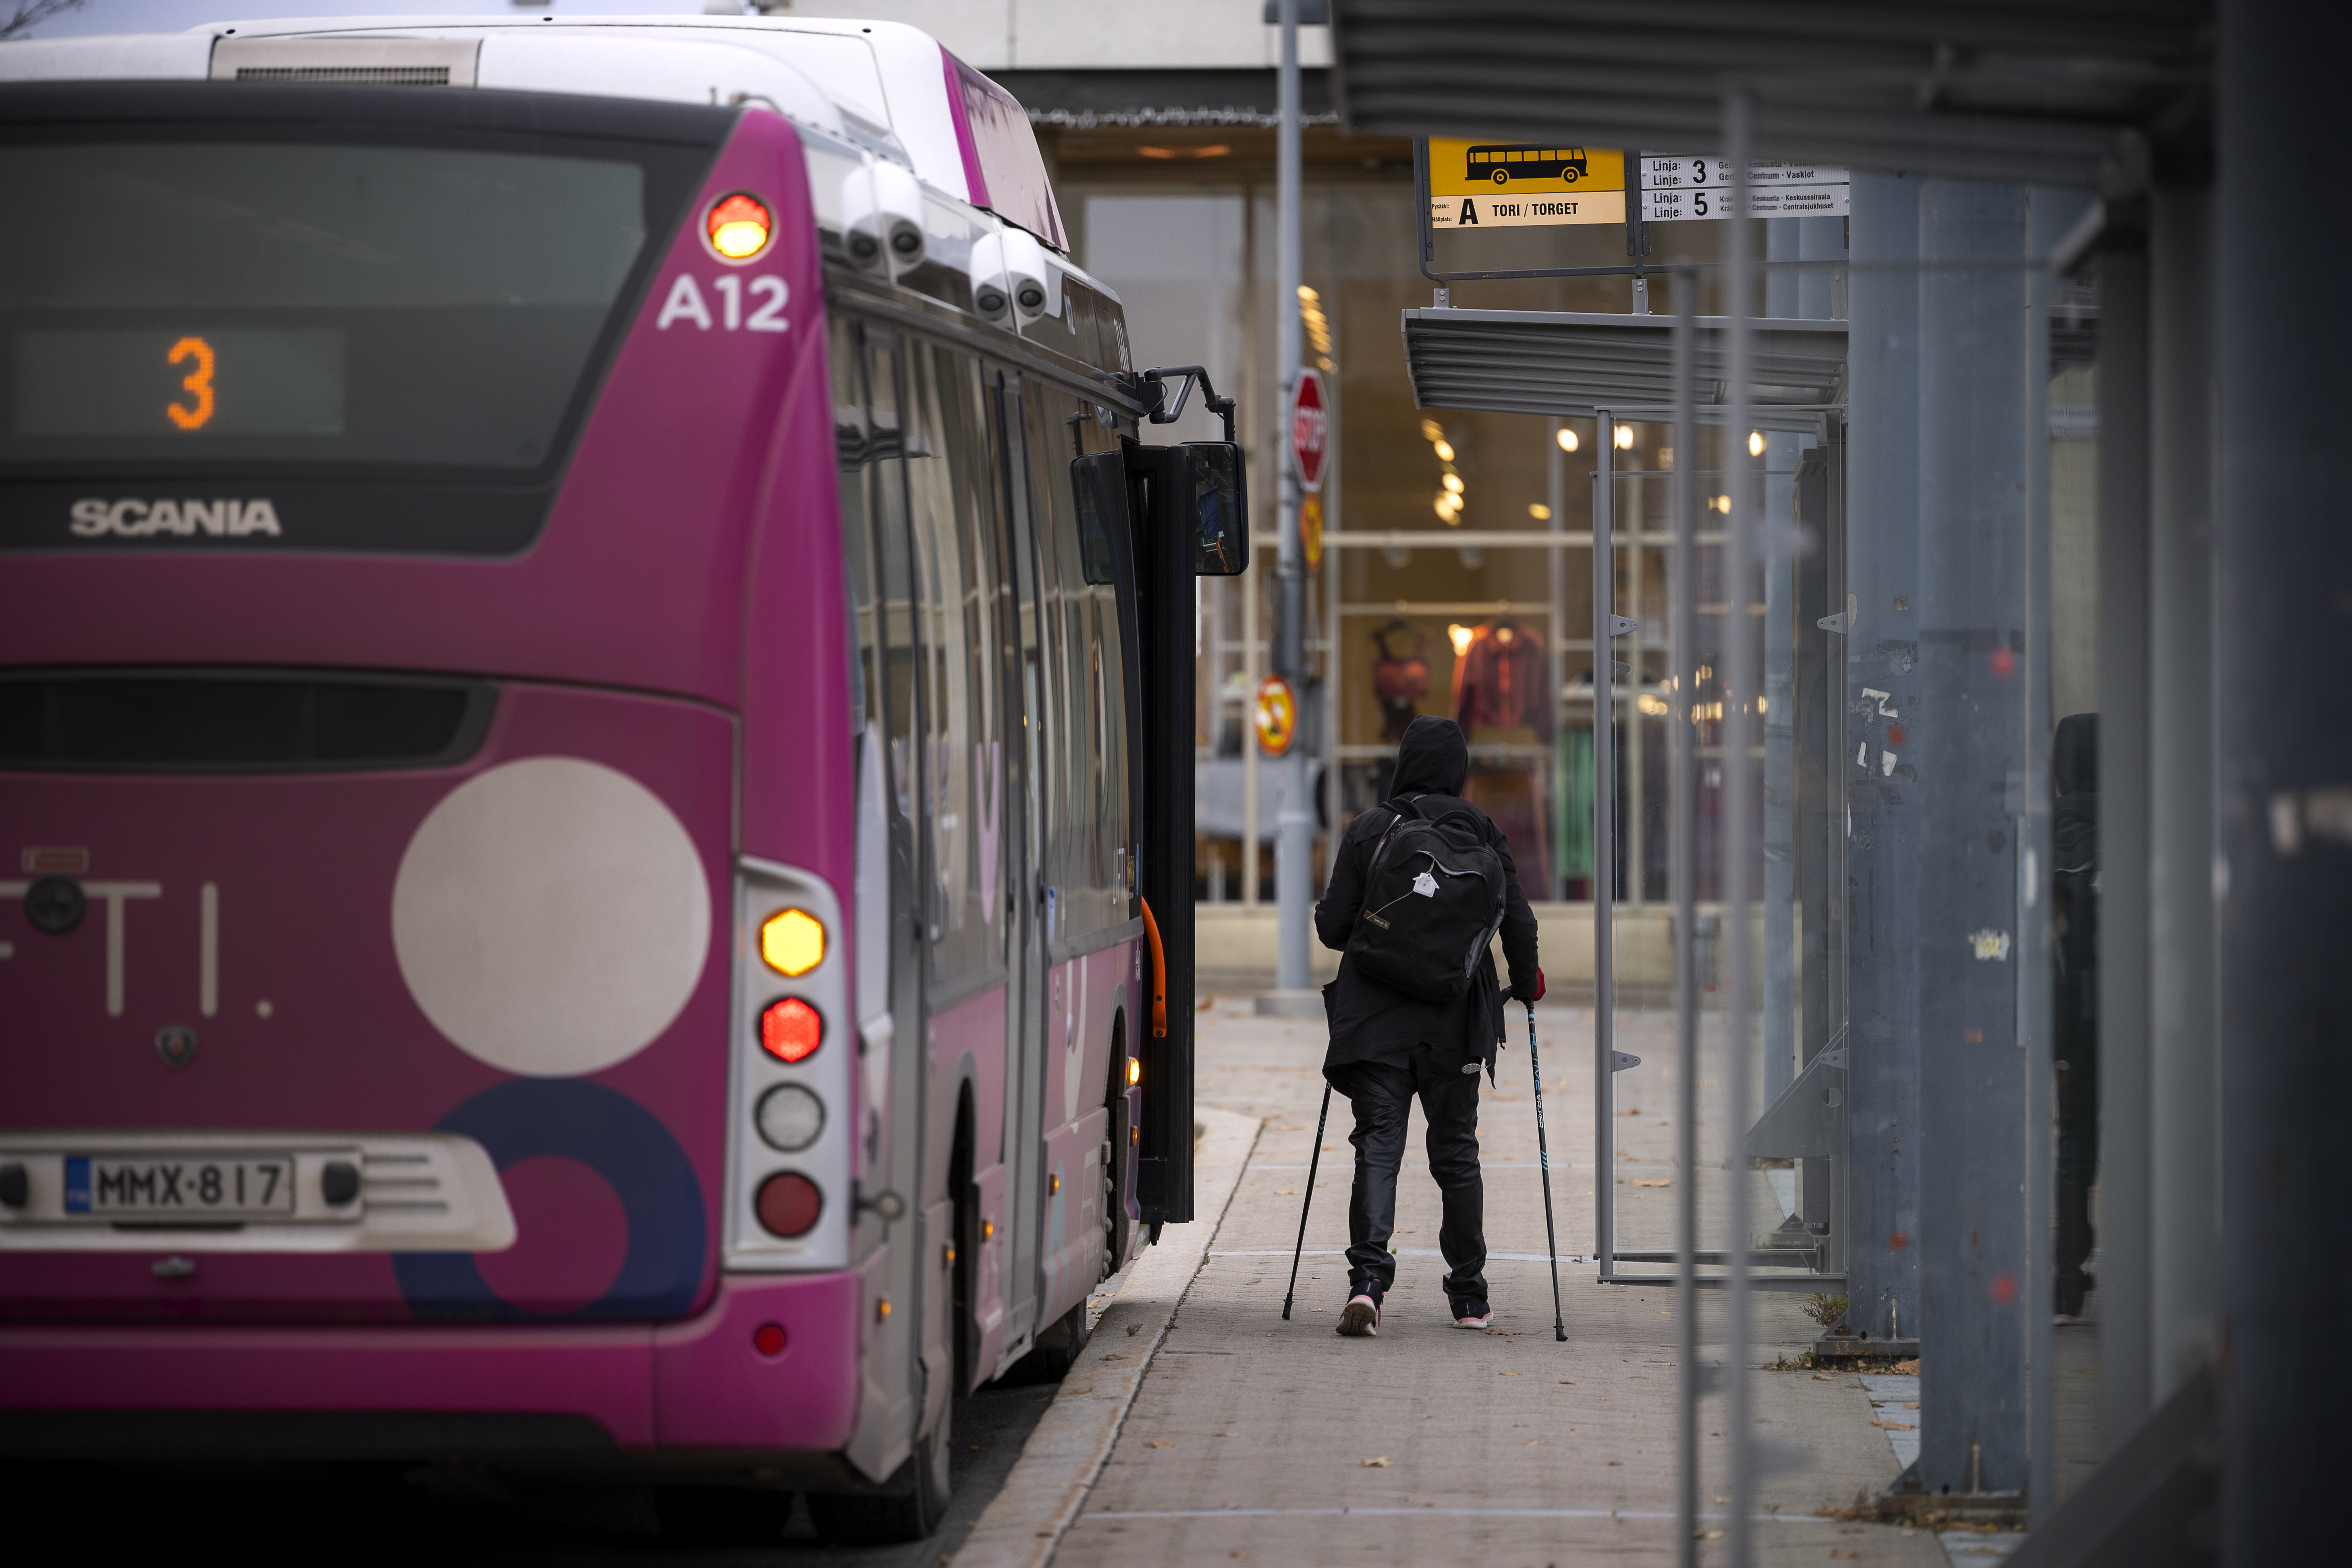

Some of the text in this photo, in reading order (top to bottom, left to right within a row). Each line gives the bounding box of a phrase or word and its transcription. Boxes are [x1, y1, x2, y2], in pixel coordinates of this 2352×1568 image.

[1653, 160, 1680, 172] Linja:
[1693, 160, 1706, 183] 3
[1654, 174, 1681, 187] Linje:
[1786, 170, 1814, 179] Vasklot
[1459, 198, 1479, 225] A
[1492, 204, 1520, 217] TORI
[1532, 203, 1578, 216] TORGET
[1654, 193, 1681, 205] Linja:
[1694, 192, 1708, 216] 5
[1654, 207, 1682, 219] Linje:
[1783, 202, 1833, 210] Centralsjukhuset
[656, 272, 790, 332] A12
[167, 336, 214, 430] 3
[70, 497, 282, 537] SCANIA
[98, 1165, 283, 1205] MMX-817
